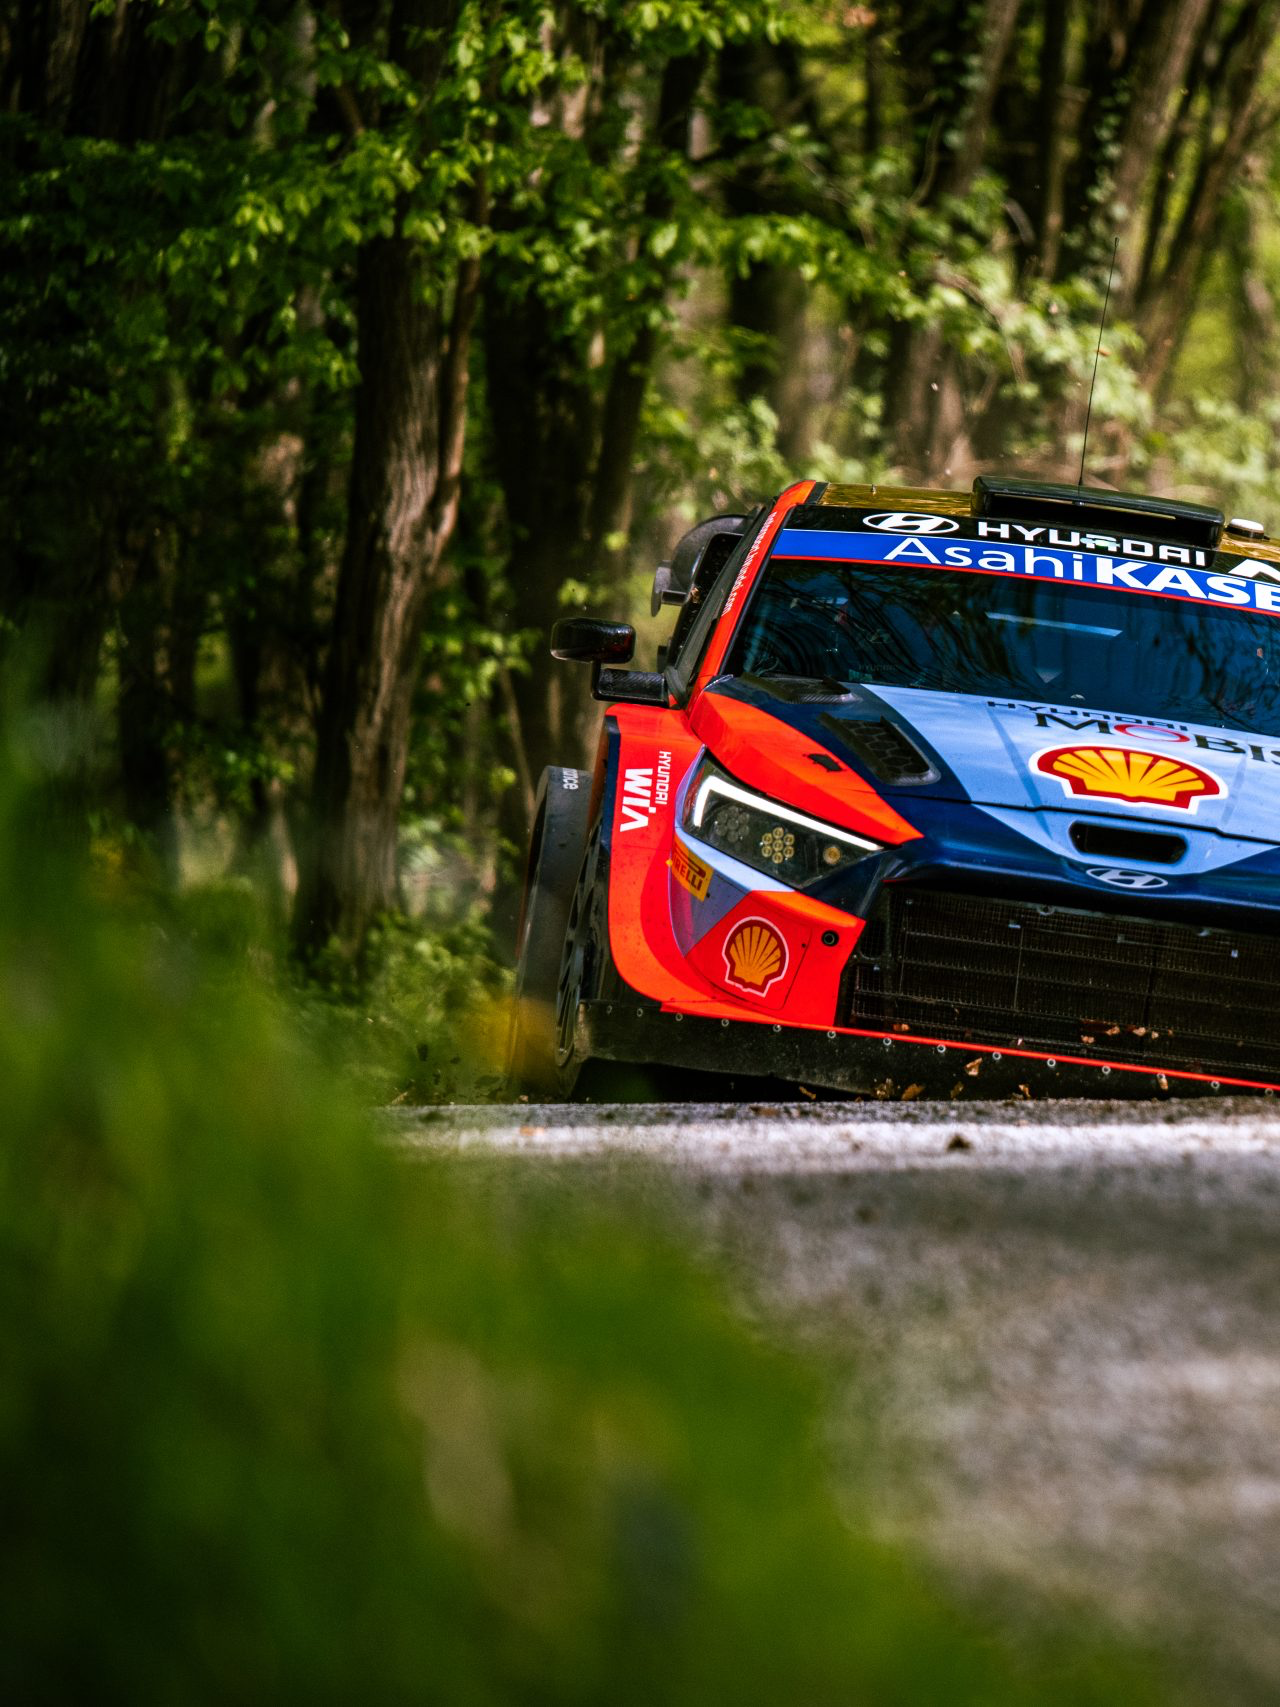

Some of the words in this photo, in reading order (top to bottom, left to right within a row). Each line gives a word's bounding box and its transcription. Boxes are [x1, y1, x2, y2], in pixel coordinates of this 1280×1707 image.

[987, 700, 1188, 732] HYUNDAI
[620, 767, 656, 832] WIA
[655, 750, 672, 805] HYUNDAI
